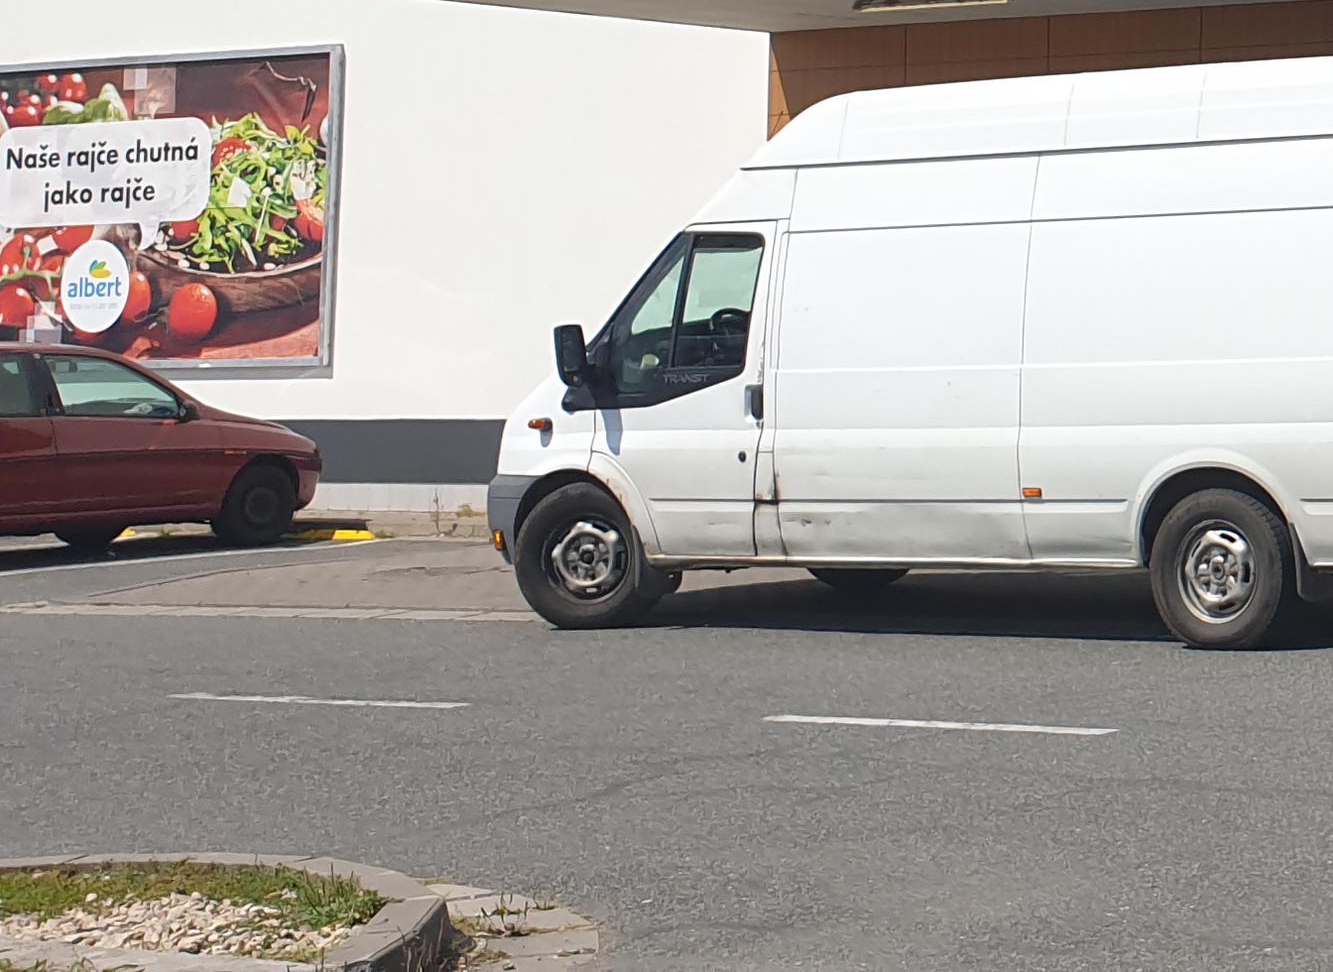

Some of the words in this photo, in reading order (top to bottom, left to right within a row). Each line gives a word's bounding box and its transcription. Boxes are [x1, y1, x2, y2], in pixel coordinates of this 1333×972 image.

[6, 144, 60, 170] Naše
[67, 140, 119, 173] rajče
[125, 137, 199, 164] chutná
[43, 181, 93, 213] jako
[100, 178, 156, 209] rajče
[67, 276, 122, 298] albert
